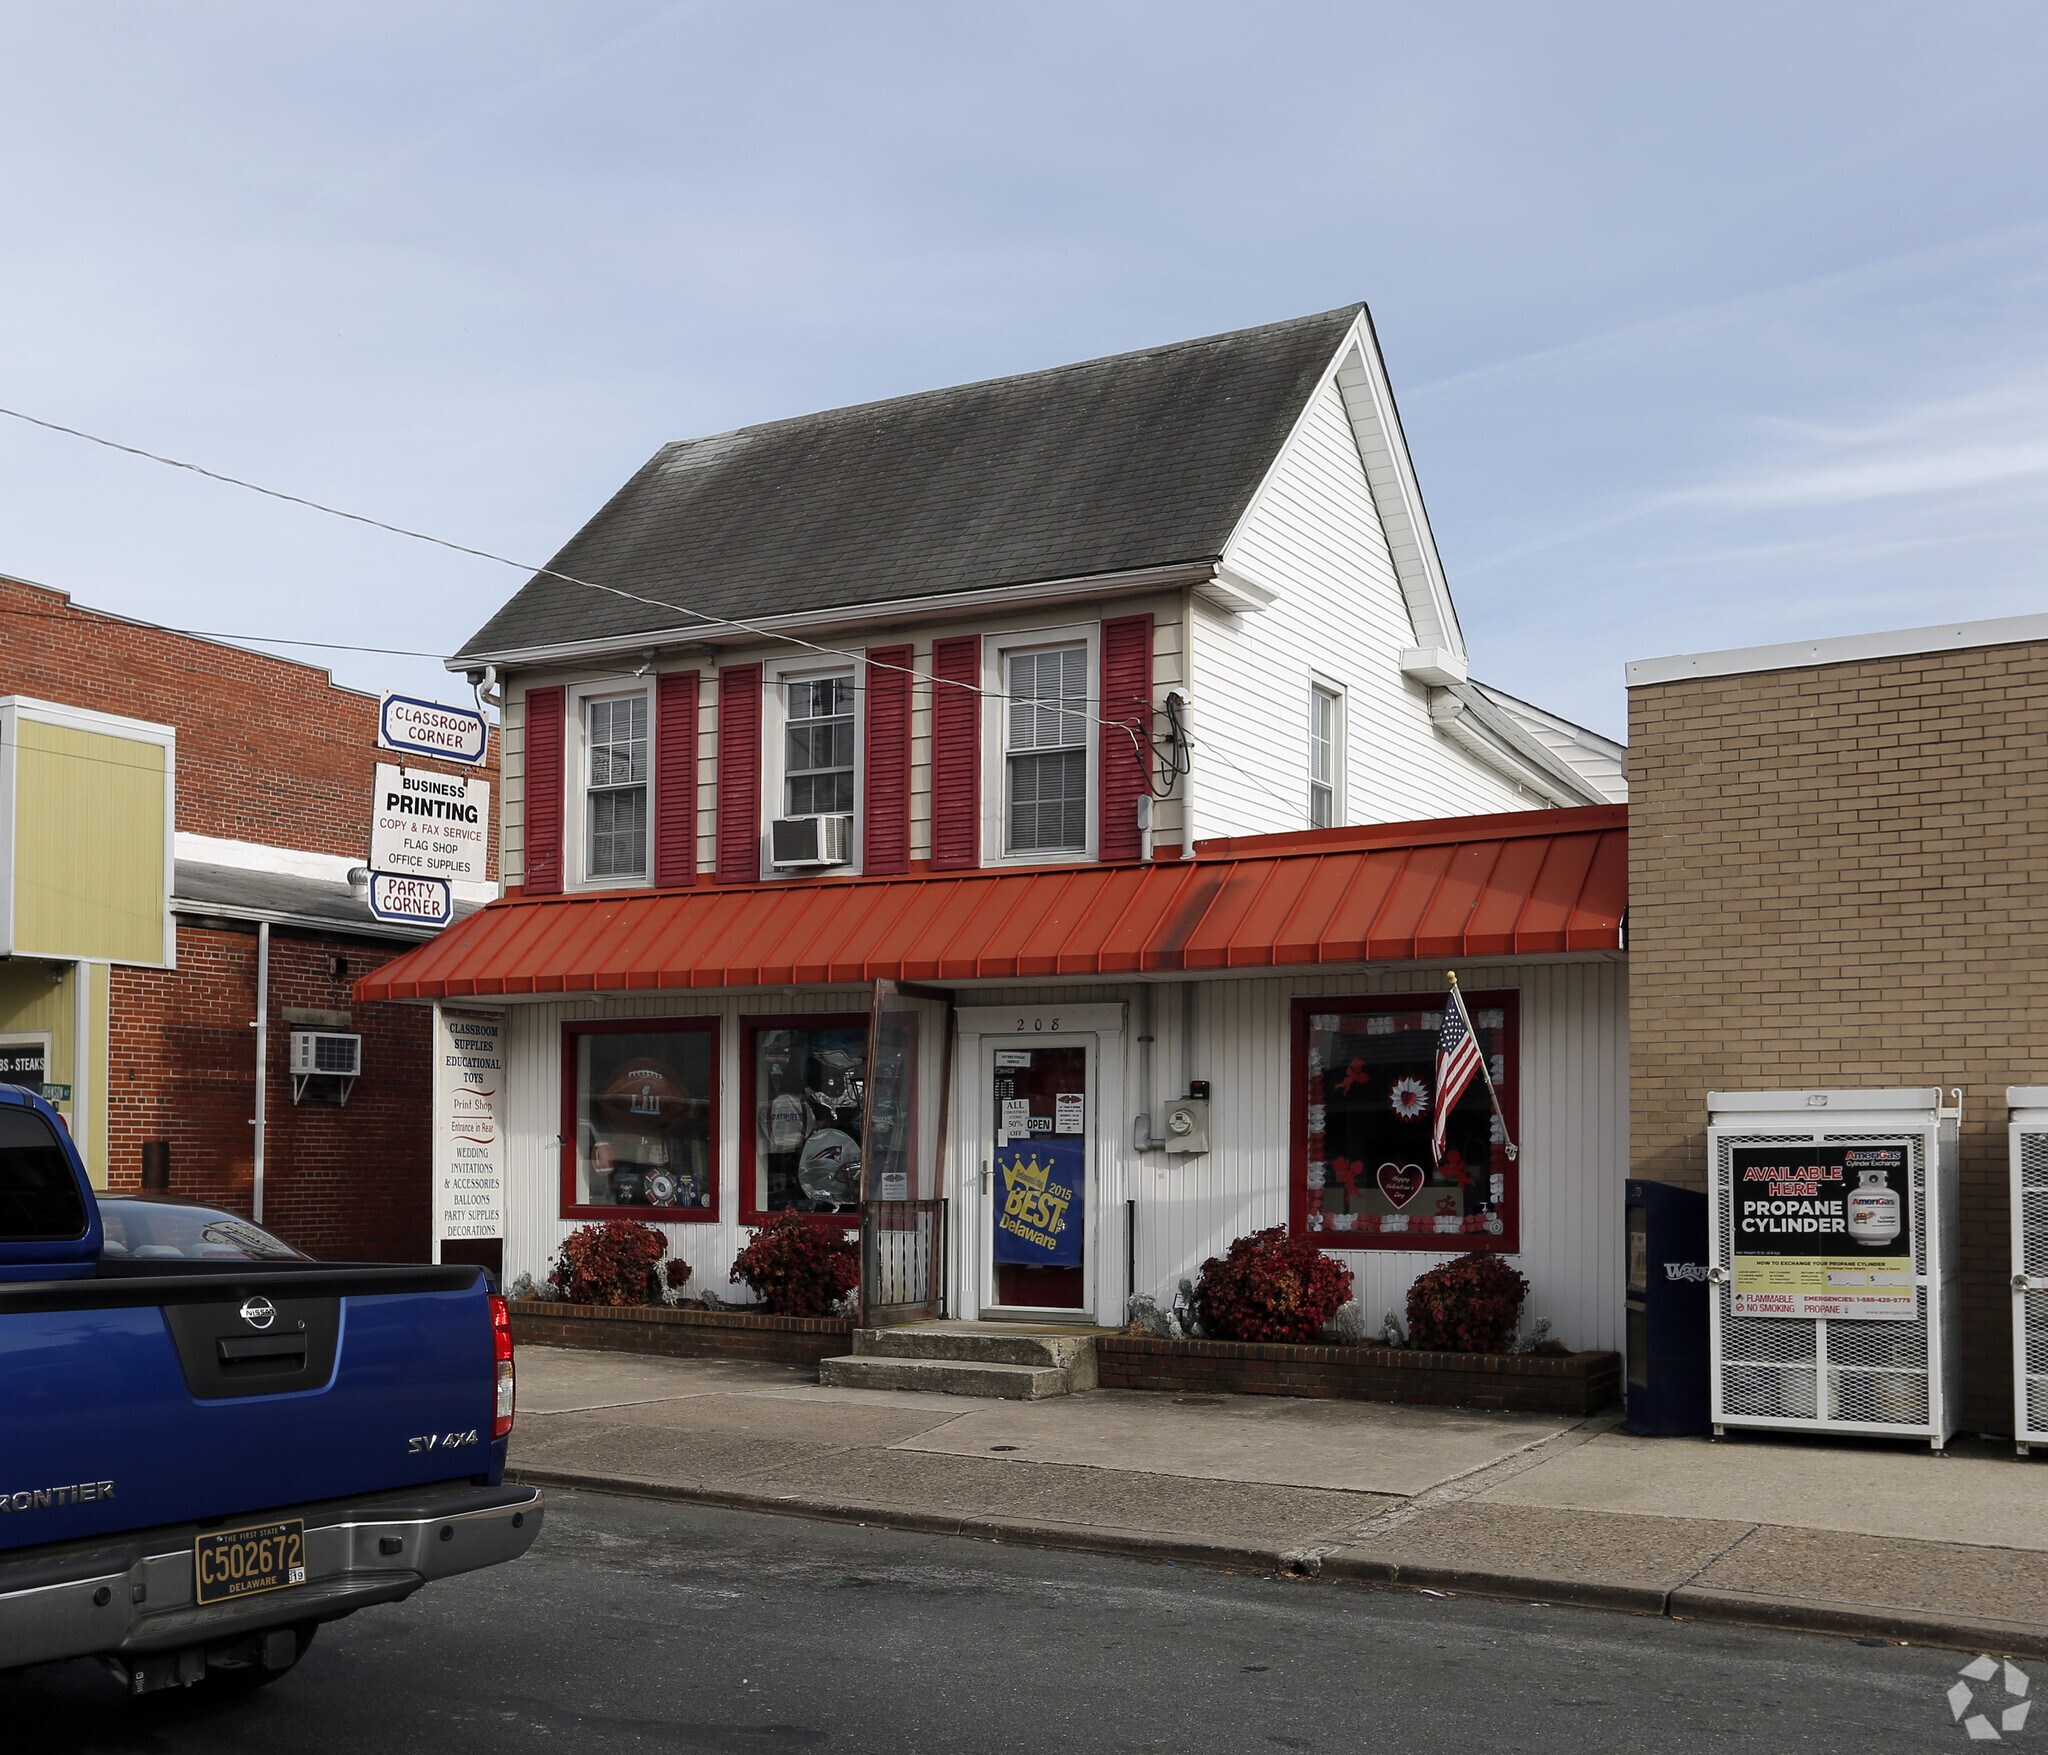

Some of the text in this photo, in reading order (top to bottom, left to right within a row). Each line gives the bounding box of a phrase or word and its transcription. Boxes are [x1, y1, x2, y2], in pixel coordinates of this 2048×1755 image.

[395, 706, 478, 734] CLASSROOM
[408, 726, 464, 749] CORNER
[402, 777, 466, 799] BUSINESS
[386, 792, 478, 824] PRINTING
[379, 817, 482, 842] COPY & FAX SERVICE
[403, 838, 459, 855] FLAG SHOP
[388, 852, 471, 873] OFFICE SUPPLIES
[388, 878, 435, 899] PARTY
[383, 895, 441, 916] CORNER
[449, 1022, 498, 1037] CLASSROOM
[1016, 1017, 1060, 1032] 208
[454, 1038, 494, 1052] SUPPLIES
[15, 1057, 44, 1071] STEAKS
[445, 1055, 501, 1070] EDUCATIONAL
[463, 1072, 484, 1084] TOYS
[453, 1099, 493, 1112] Print Shop
[1006, 1101, 1024, 1110] ALL
[451, 1121, 494, 1133] Entrance in Rear
[1008, 1120, 1024, 1128] 50%
[1027, 1119, 1050, 1130] OPEN
[456, 1147, 489, 1158] WEDDING
[1845, 1150, 1901, 1160] AmeriGas
[451, 1163, 494, 1174] INVITATIONS
[1846, 1160, 1870, 1168] Cylinder
[1391, 1175, 1410, 1184] Happy
[1743, 1166, 1843, 1181] AVAILABLE
[444, 1178, 500, 1190] & ACCESSORIES
[1385, 1183, 1414, 1191] Valentine's
[1768, 1181, 1818, 1197] HERE
[1048, 1182, 1073, 1201] 2015
[1393, 1191, 1405, 1199] Day
[453, 1194, 491, 1205] BALLOONS
[1004, 1180, 1069, 1233] BEST
[1852, 1198, 1895, 1206] AmeriGas
[444, 1209, 500, 1221] PARTY SUPPLIES
[1743, 1200, 1843, 1216] PROPANE
[447, 1225, 496, 1237] DECORATIONS
[998, 1213, 1057, 1251] Delaware
[1741, 1217, 1846, 1233] CYLINDER
[1746, 1294, 1794, 1303] FLAMMABLE
[1746, 1303, 1795, 1313] NO SMOKING
[1804, 1305, 1841, 1314] PROPANE
[408, 1434, 437, 1454] SV
[224, 1527, 278, 1543] THE FIRST STATE
[201, 1533, 302, 1584] C502672
[293, 1571, 303, 1581] 19
[229, 1576, 277, 1593] DELAWARE
